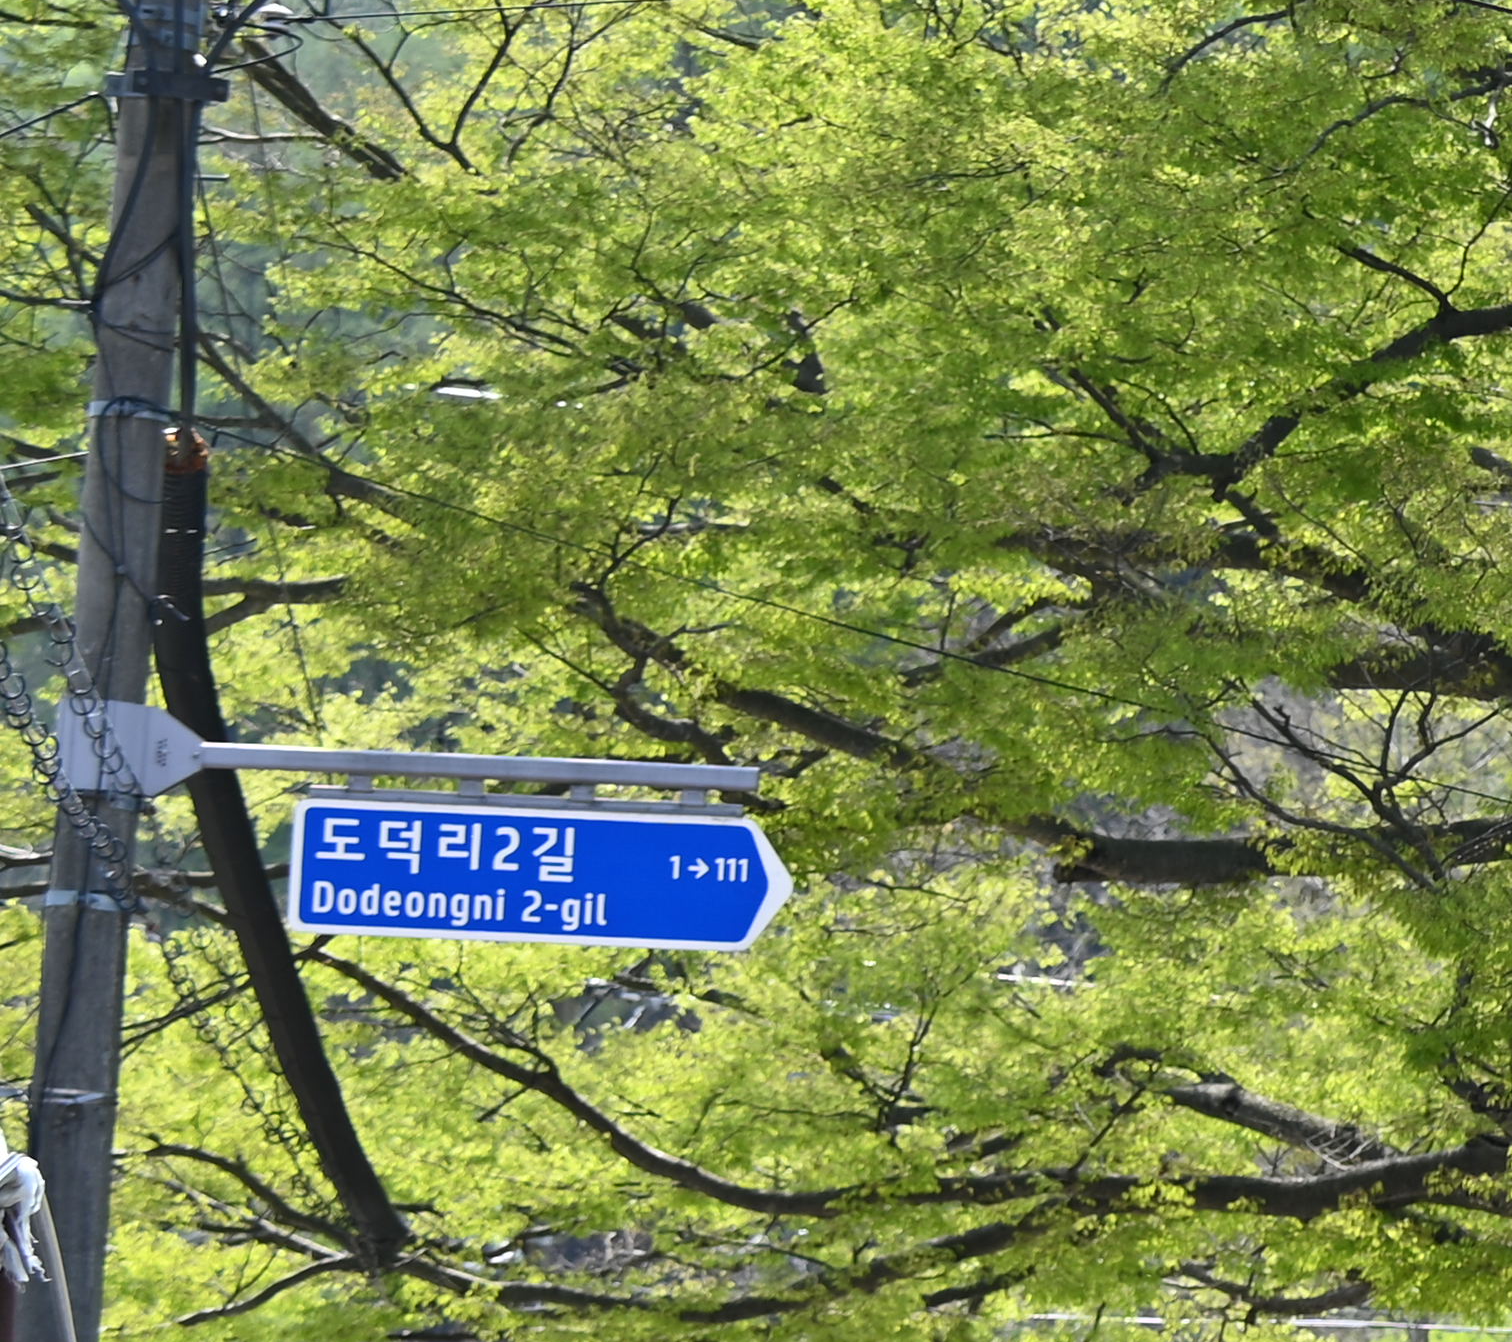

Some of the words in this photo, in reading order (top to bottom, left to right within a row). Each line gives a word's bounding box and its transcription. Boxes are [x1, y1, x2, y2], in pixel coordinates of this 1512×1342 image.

[315, 817, 575, 884] 도덕리2길
[312, 880, 505, 927] Dodeongni
[521, 889, 607, 931] 2-gil
